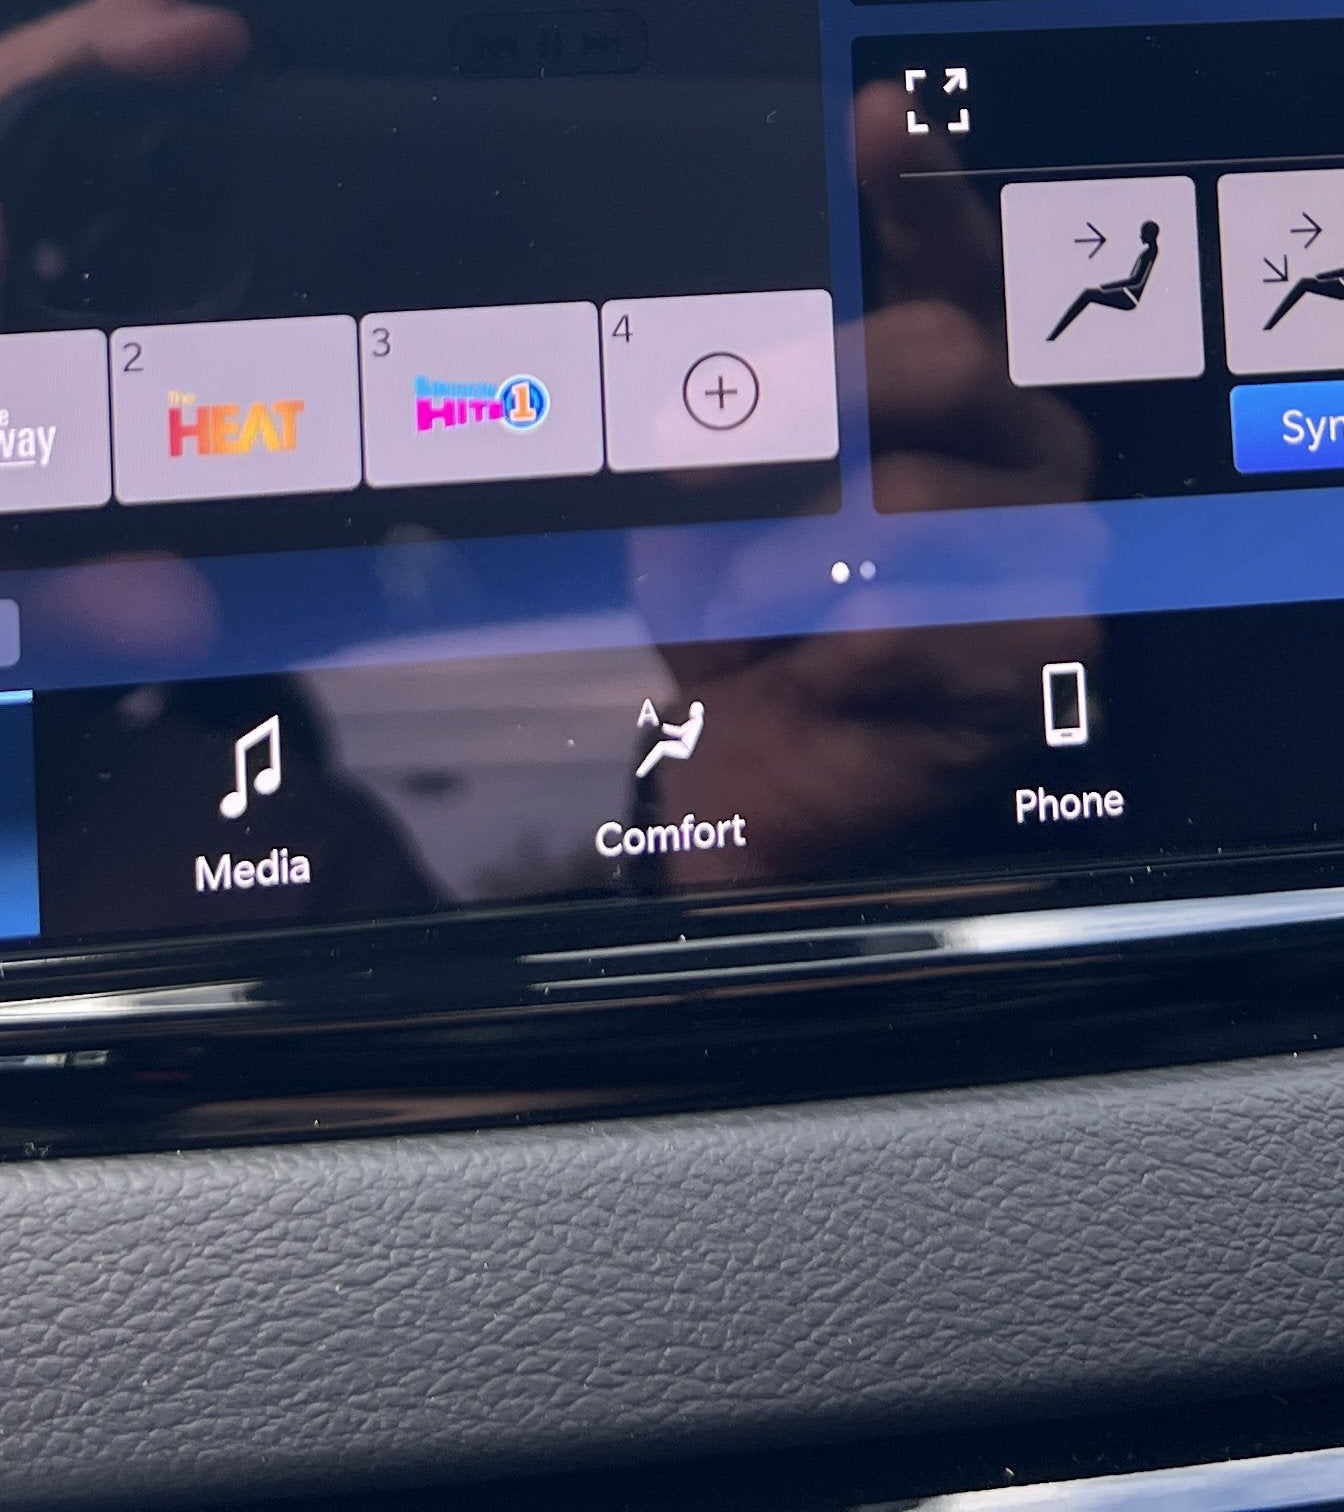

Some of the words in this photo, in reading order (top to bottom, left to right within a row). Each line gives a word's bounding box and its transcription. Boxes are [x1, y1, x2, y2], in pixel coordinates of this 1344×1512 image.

[372, 327, 391, 357] 3
[612, 315, 631, 343] 4
[123, 342, 143, 373] 2
[167, 399, 305, 457] HEAT
[1015, 786, 1125, 824] Phone
[595, 813, 747, 857] Comfort
[195, 847, 311, 892] Media
